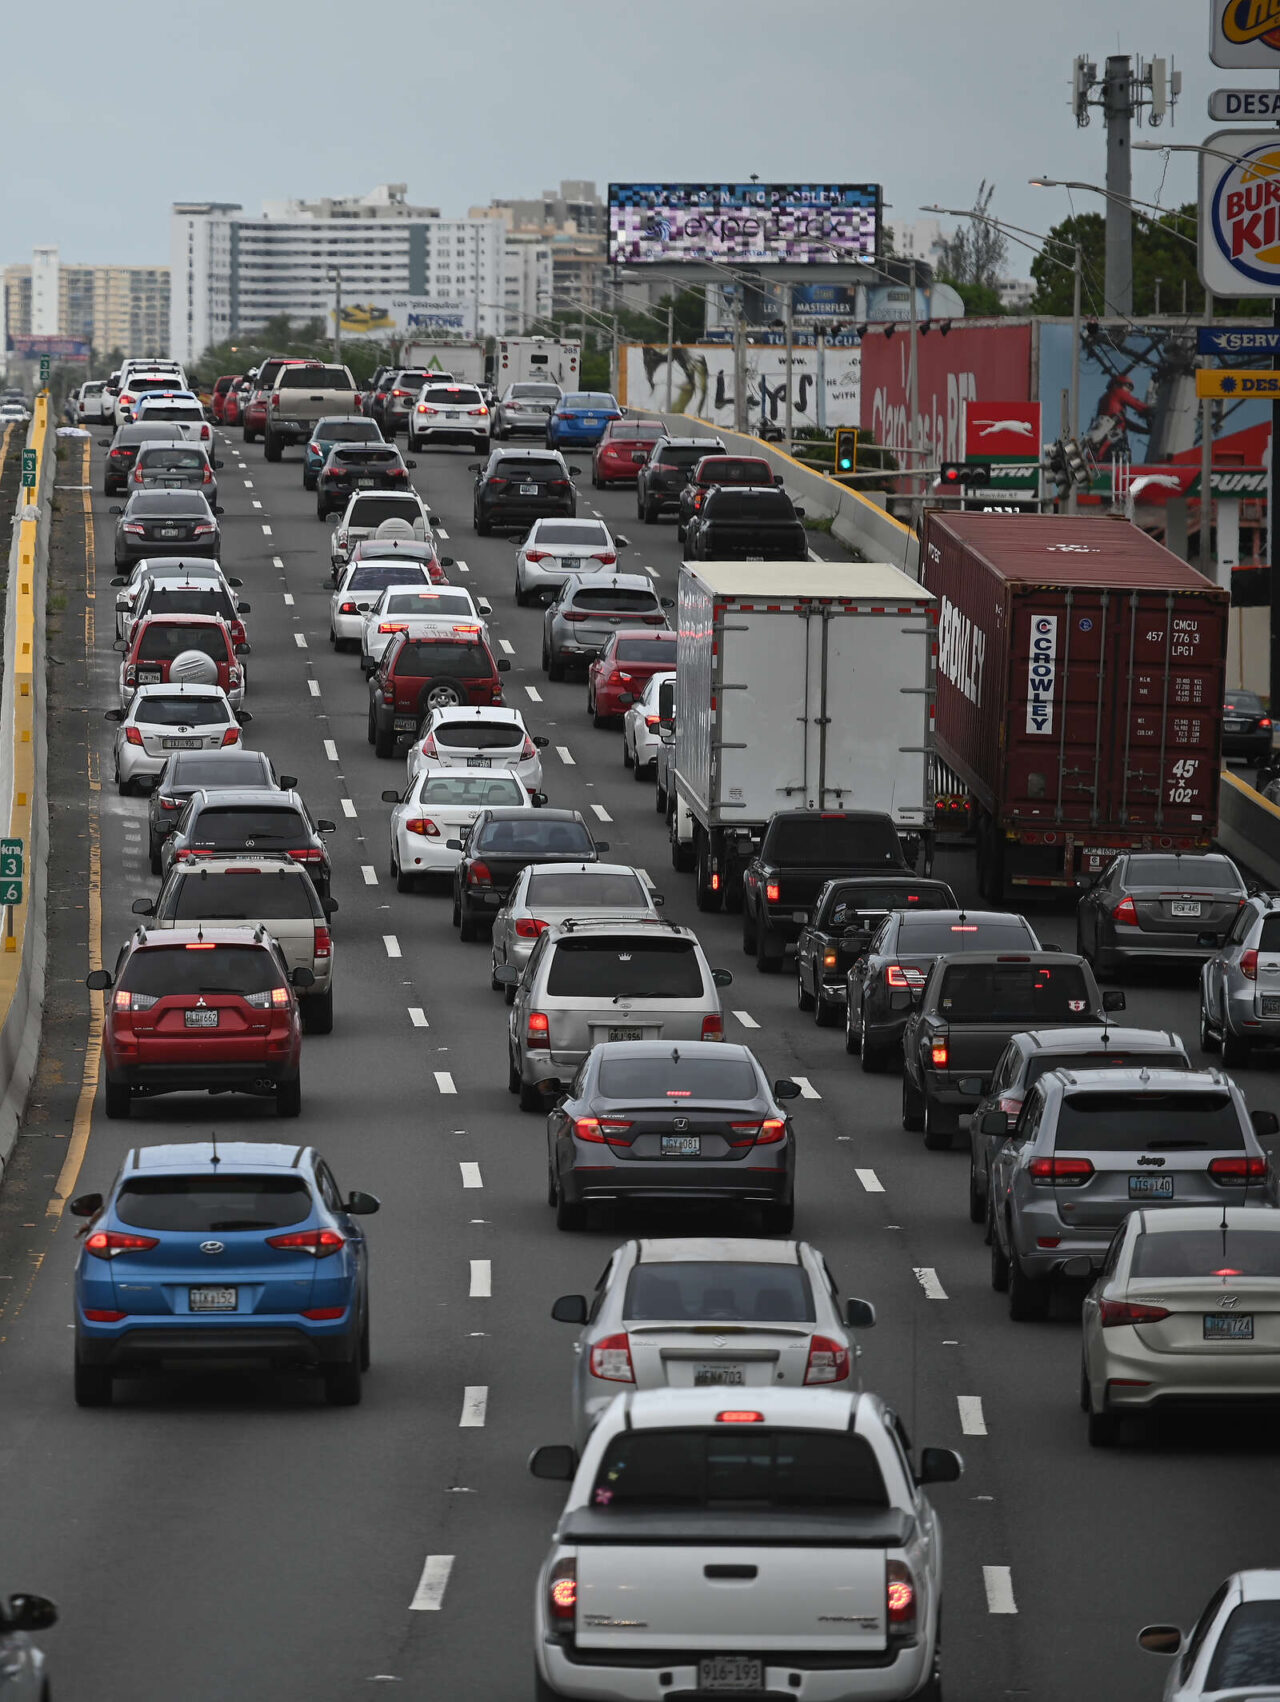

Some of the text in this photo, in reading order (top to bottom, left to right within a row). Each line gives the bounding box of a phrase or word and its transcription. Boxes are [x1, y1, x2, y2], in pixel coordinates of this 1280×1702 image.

[832, 391, 856, 400] WITH
[26, 461, 33, 470] 3
[1173, 619, 1198, 631] CMCU
[1146, 631, 1200, 644] 457 776 3
[1030, 637, 1053, 731] CROWLEY
[1172, 760, 1198, 778] 45'
[1169, 788, 1198, 803] 102"
[1, 844, 21, 855] km
[5, 858, 17, 875] 3
[683, 1138, 697, 1149] 081
[1137, 1155, 1165, 1167] Jeep
[1154, 1180, 1170, 1192] 140
[1231, 1317, 1250, 1331] 724
[724, 1371, 742, 1384] 703
[702, 1664, 760, 1680] 916-193
